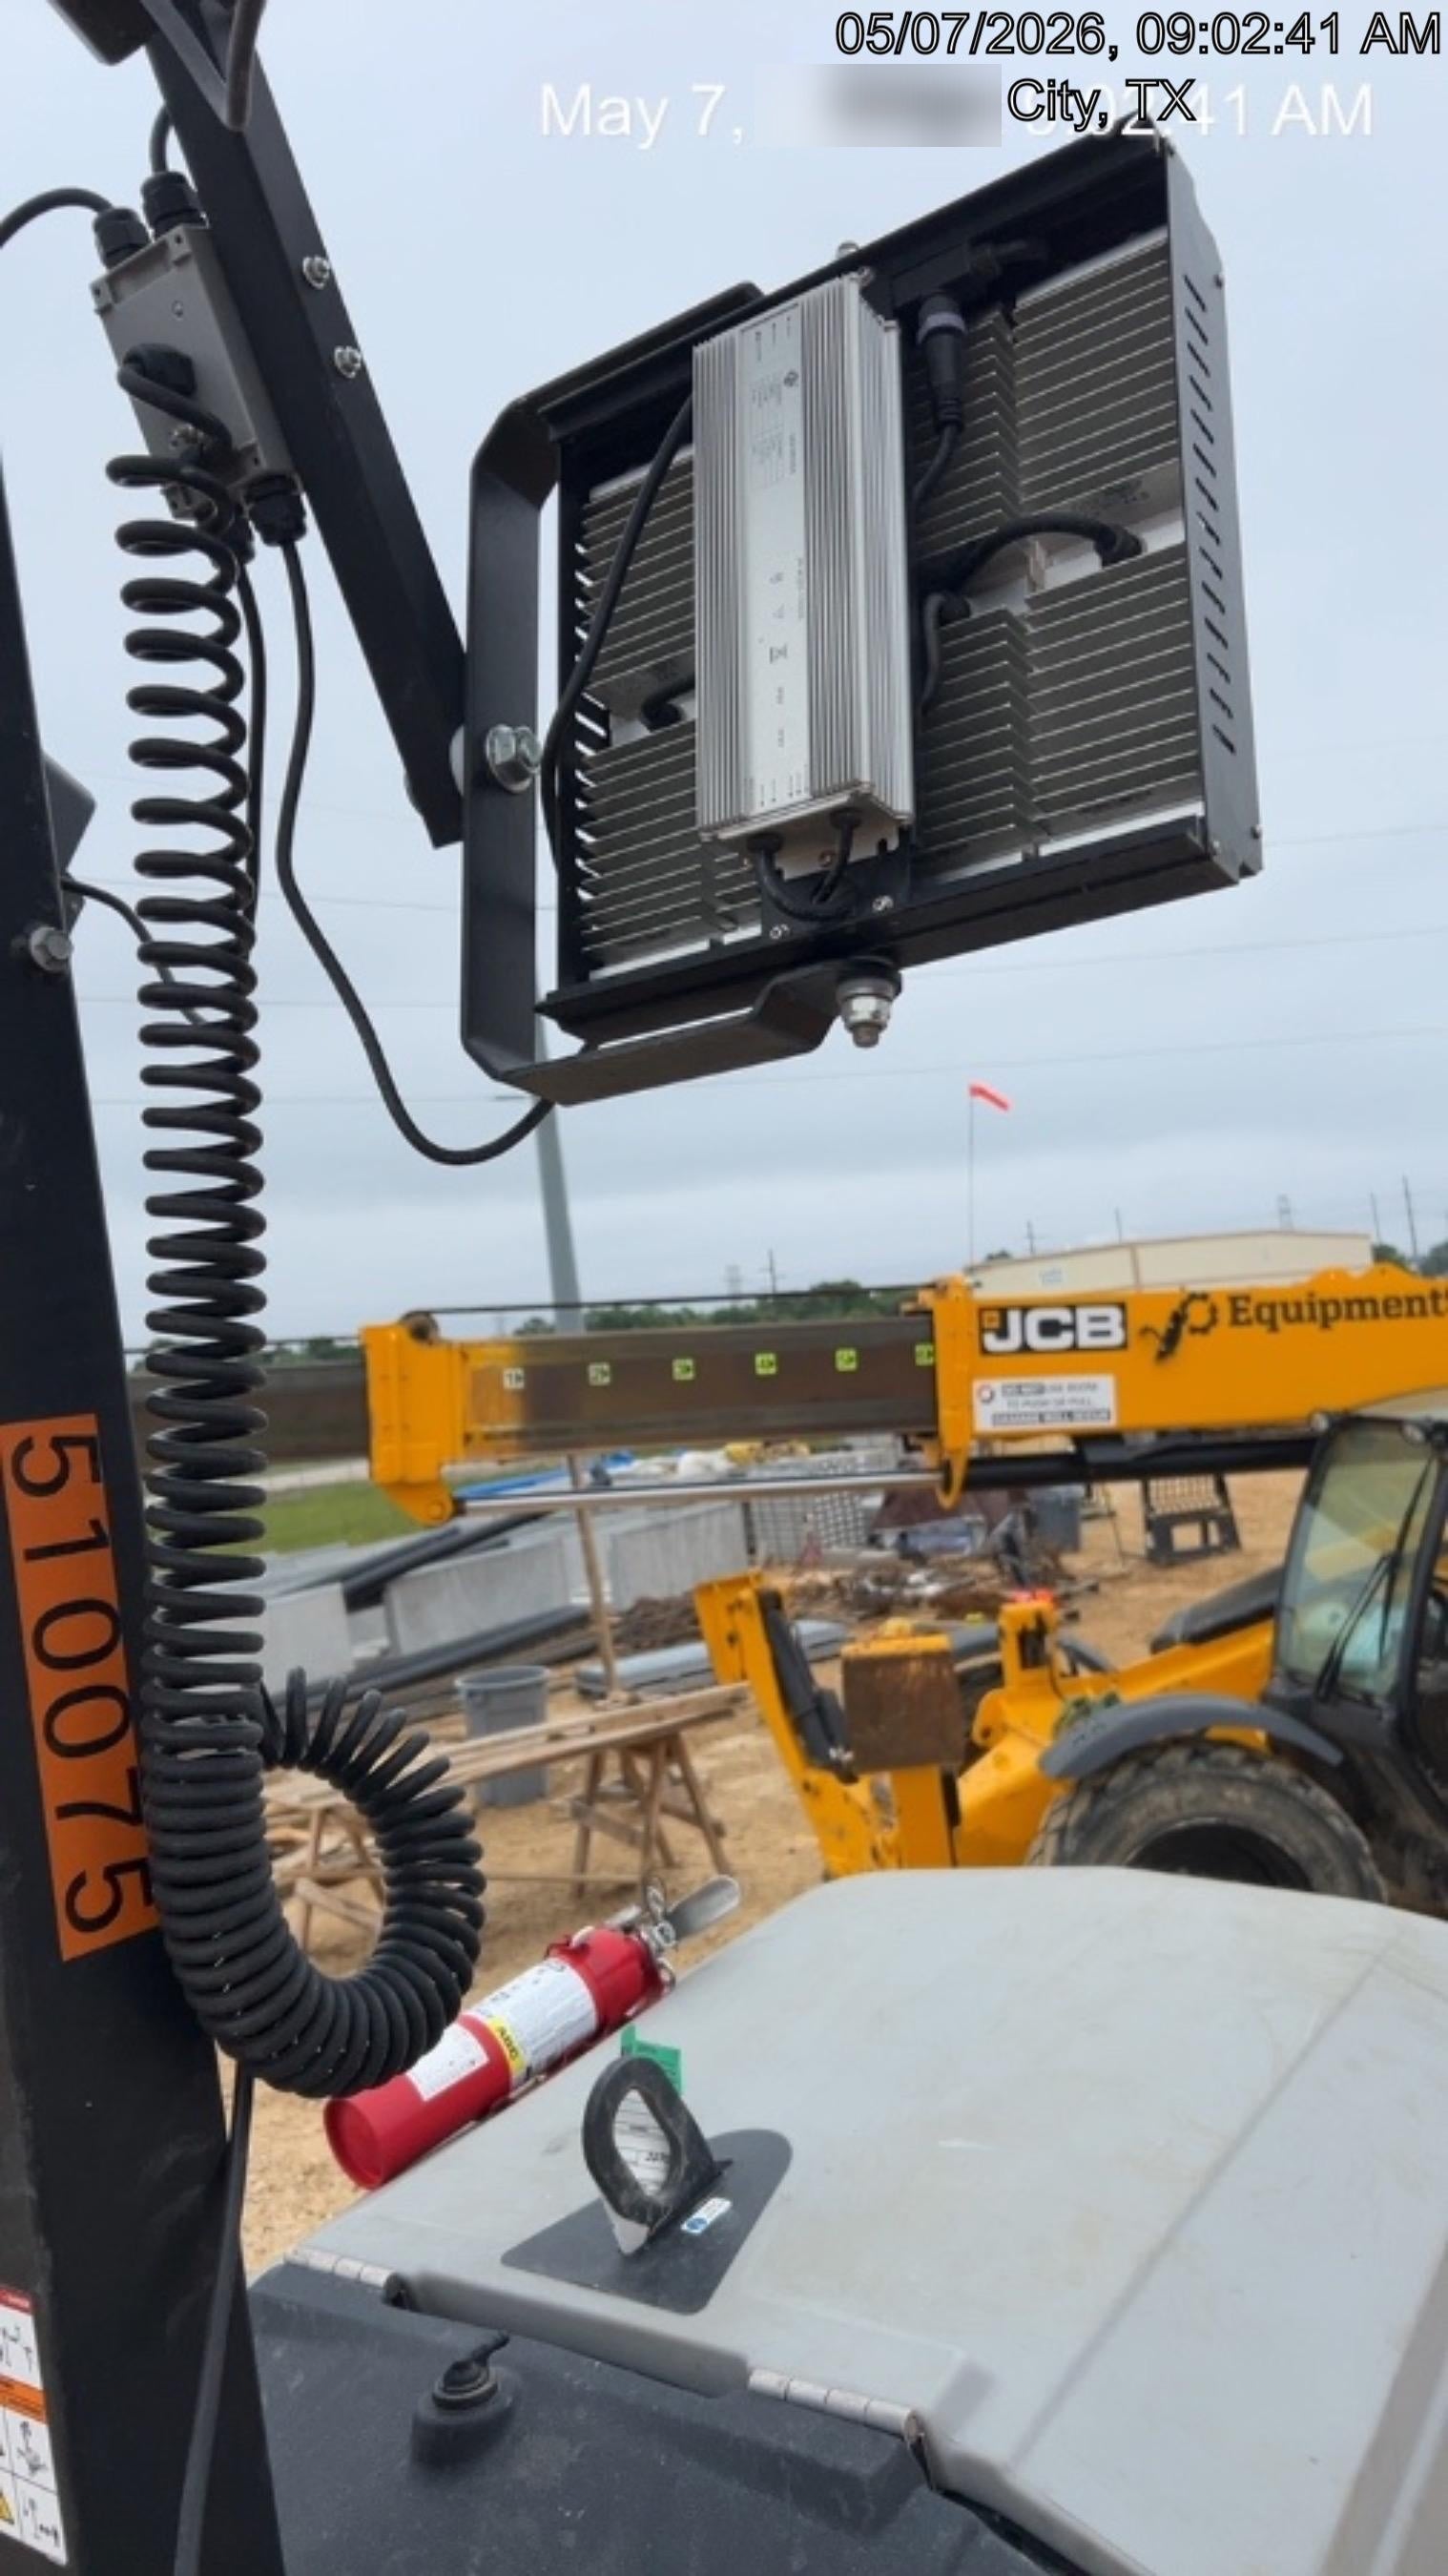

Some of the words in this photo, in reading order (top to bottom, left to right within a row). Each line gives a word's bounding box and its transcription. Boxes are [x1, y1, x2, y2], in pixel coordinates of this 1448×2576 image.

[983, 1305, 1126, 1353] JCB
[1229, 1288, 1448, 1333] Equipment
[10, 1435, 154, 1933] 510075
